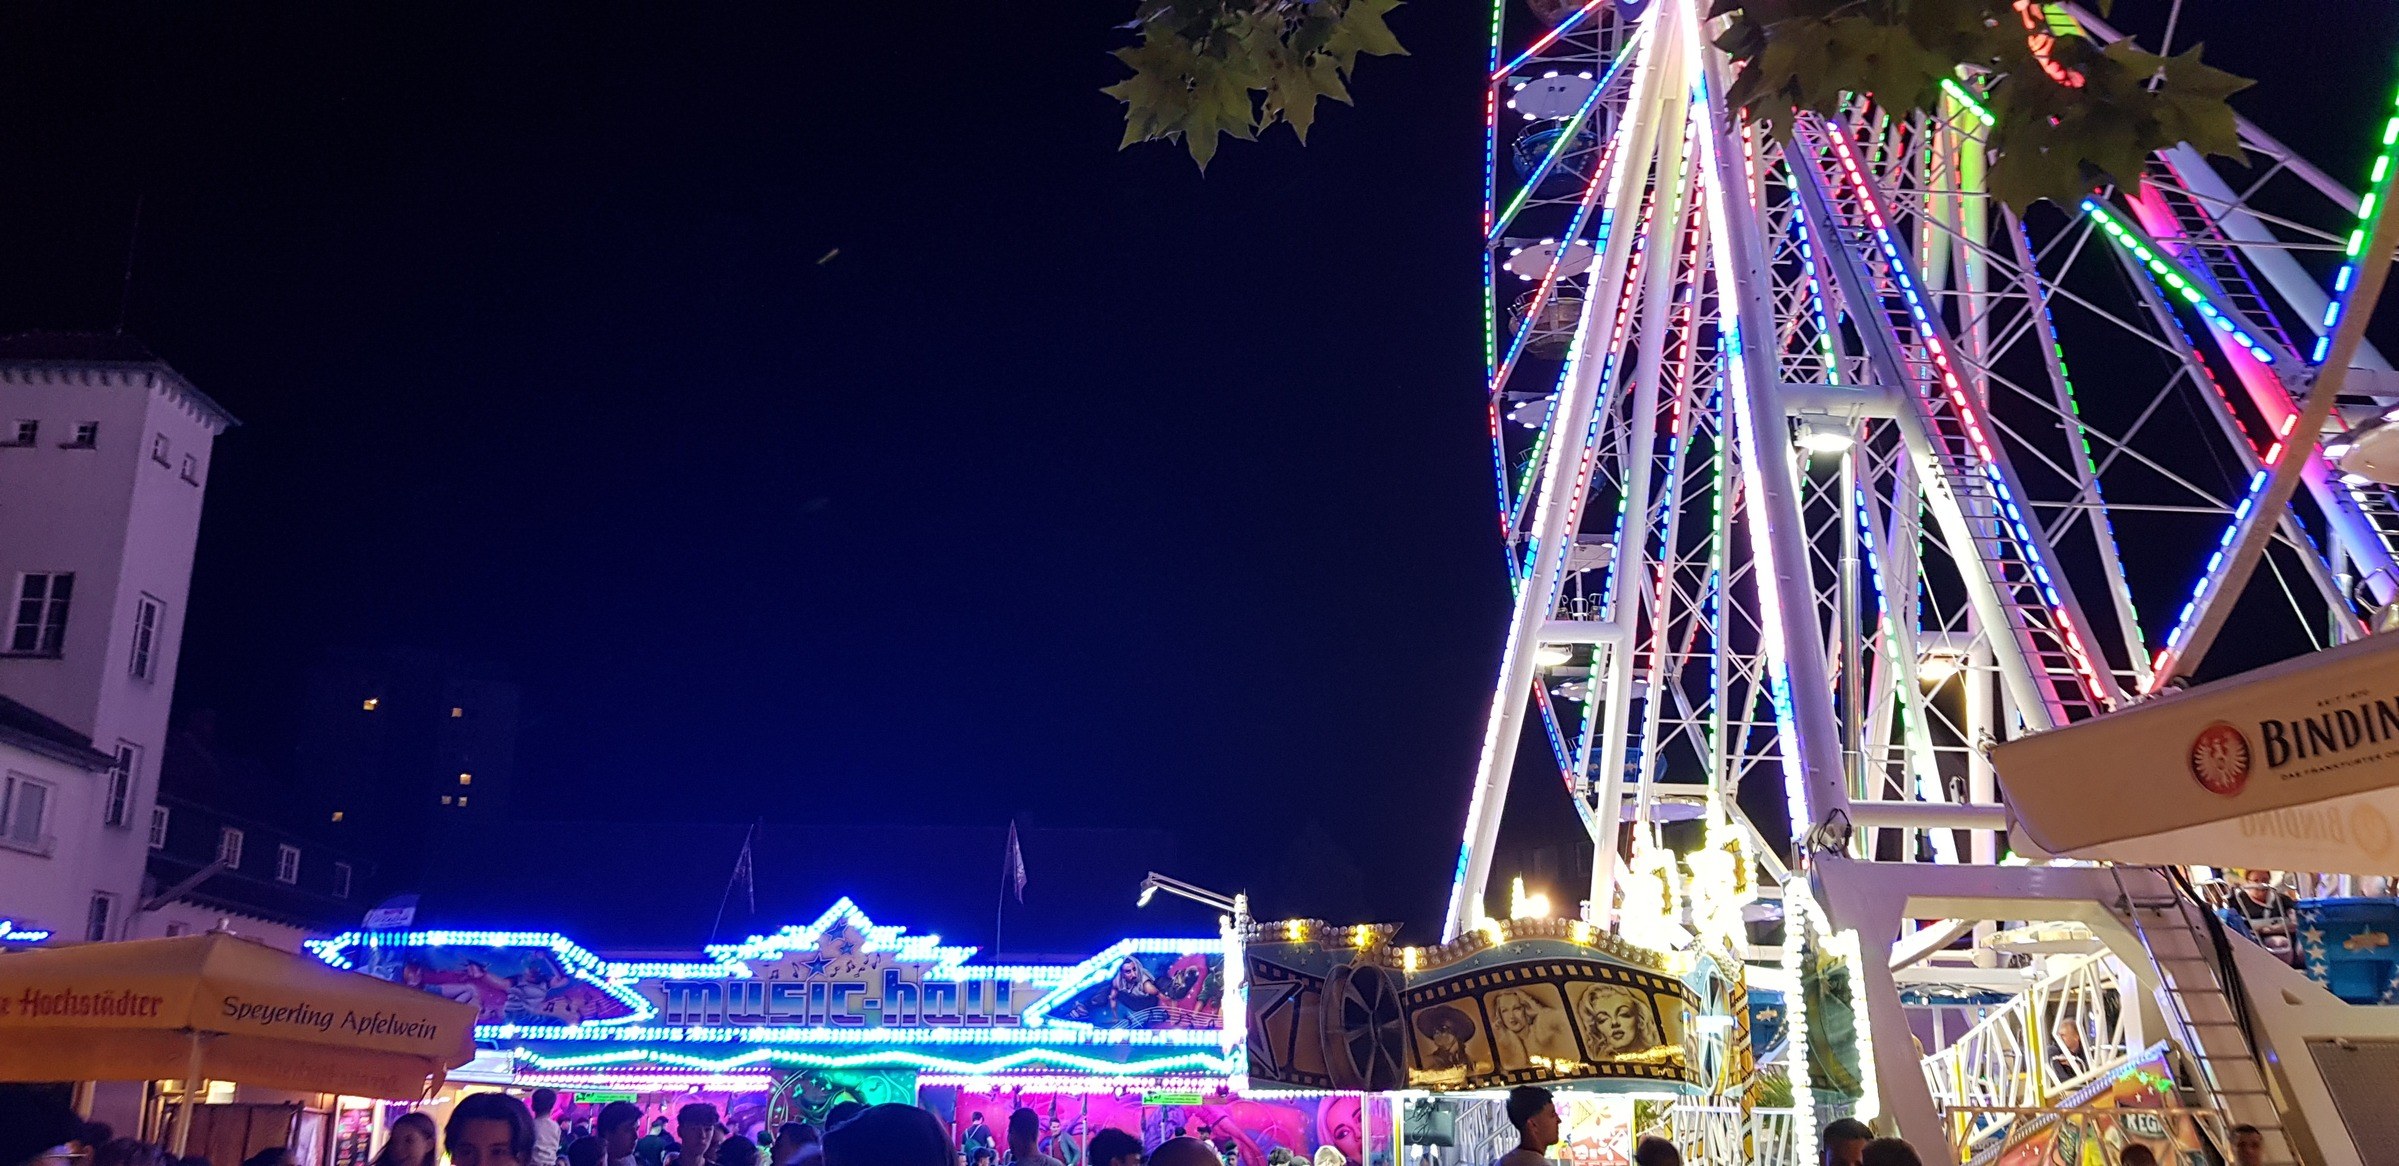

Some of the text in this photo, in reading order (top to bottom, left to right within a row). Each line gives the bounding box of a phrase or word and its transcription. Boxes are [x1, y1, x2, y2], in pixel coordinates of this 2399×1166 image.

[18, 986, 164, 1018] Hochstädter
[222, 996, 438, 1041] Speyerling Apfelwein
